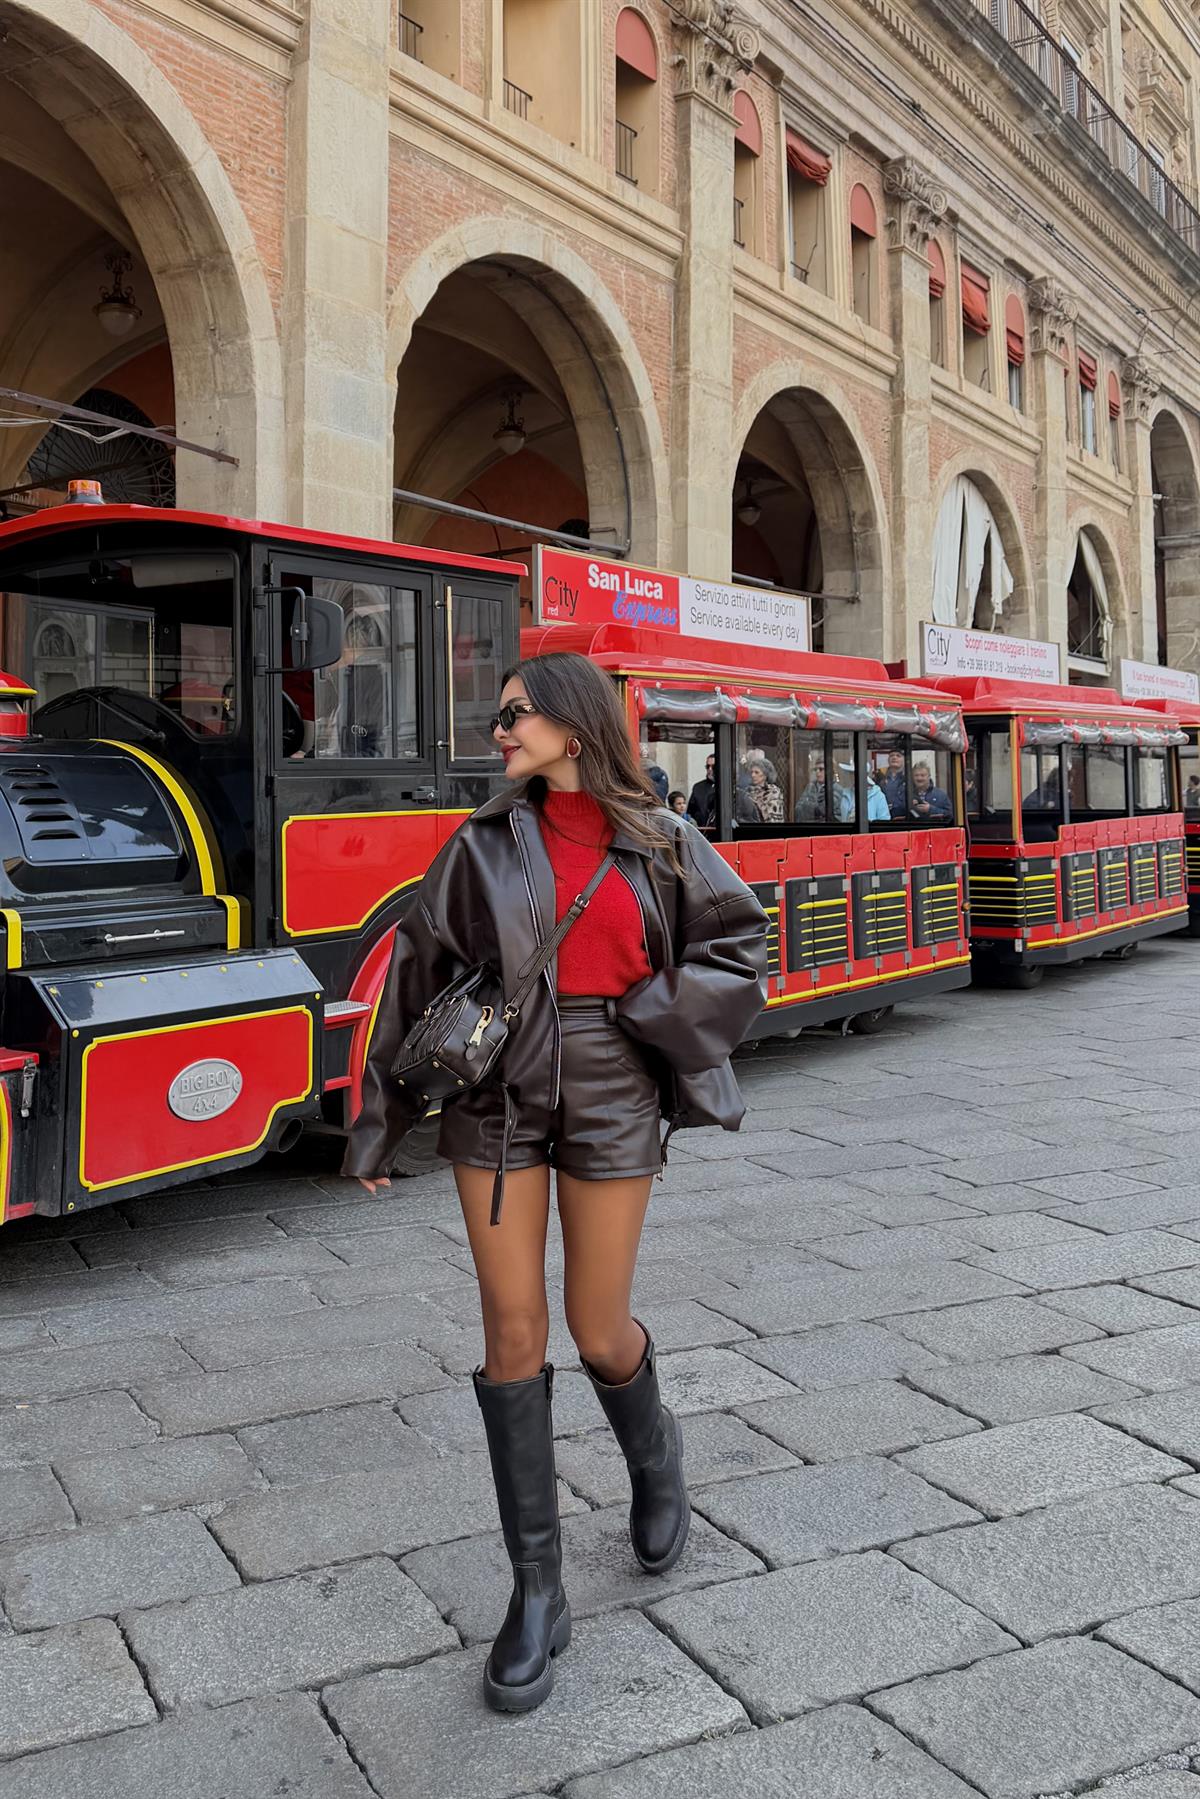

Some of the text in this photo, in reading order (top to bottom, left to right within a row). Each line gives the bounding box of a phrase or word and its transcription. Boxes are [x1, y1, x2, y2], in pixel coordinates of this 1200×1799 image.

[545, 576, 579, 616] City
[588, 563, 664, 600] San Luca
[547, 605, 559, 616] red
[612, 590, 678, 627] Express
[695, 583, 729, 606] Servizio
[731, 592, 751, 609] attivi
[752, 596, 769, 612] tutti
[774, 600, 796, 618] giorni
[690, 606, 800, 643] Service available every day
[927, 628, 950, 665] City
[965, 633, 983, 653] Scopri
[984, 640, 998, 652] come
[351, 724, 368, 737] City
[180, 1069, 231, 1094] BIG BOY
